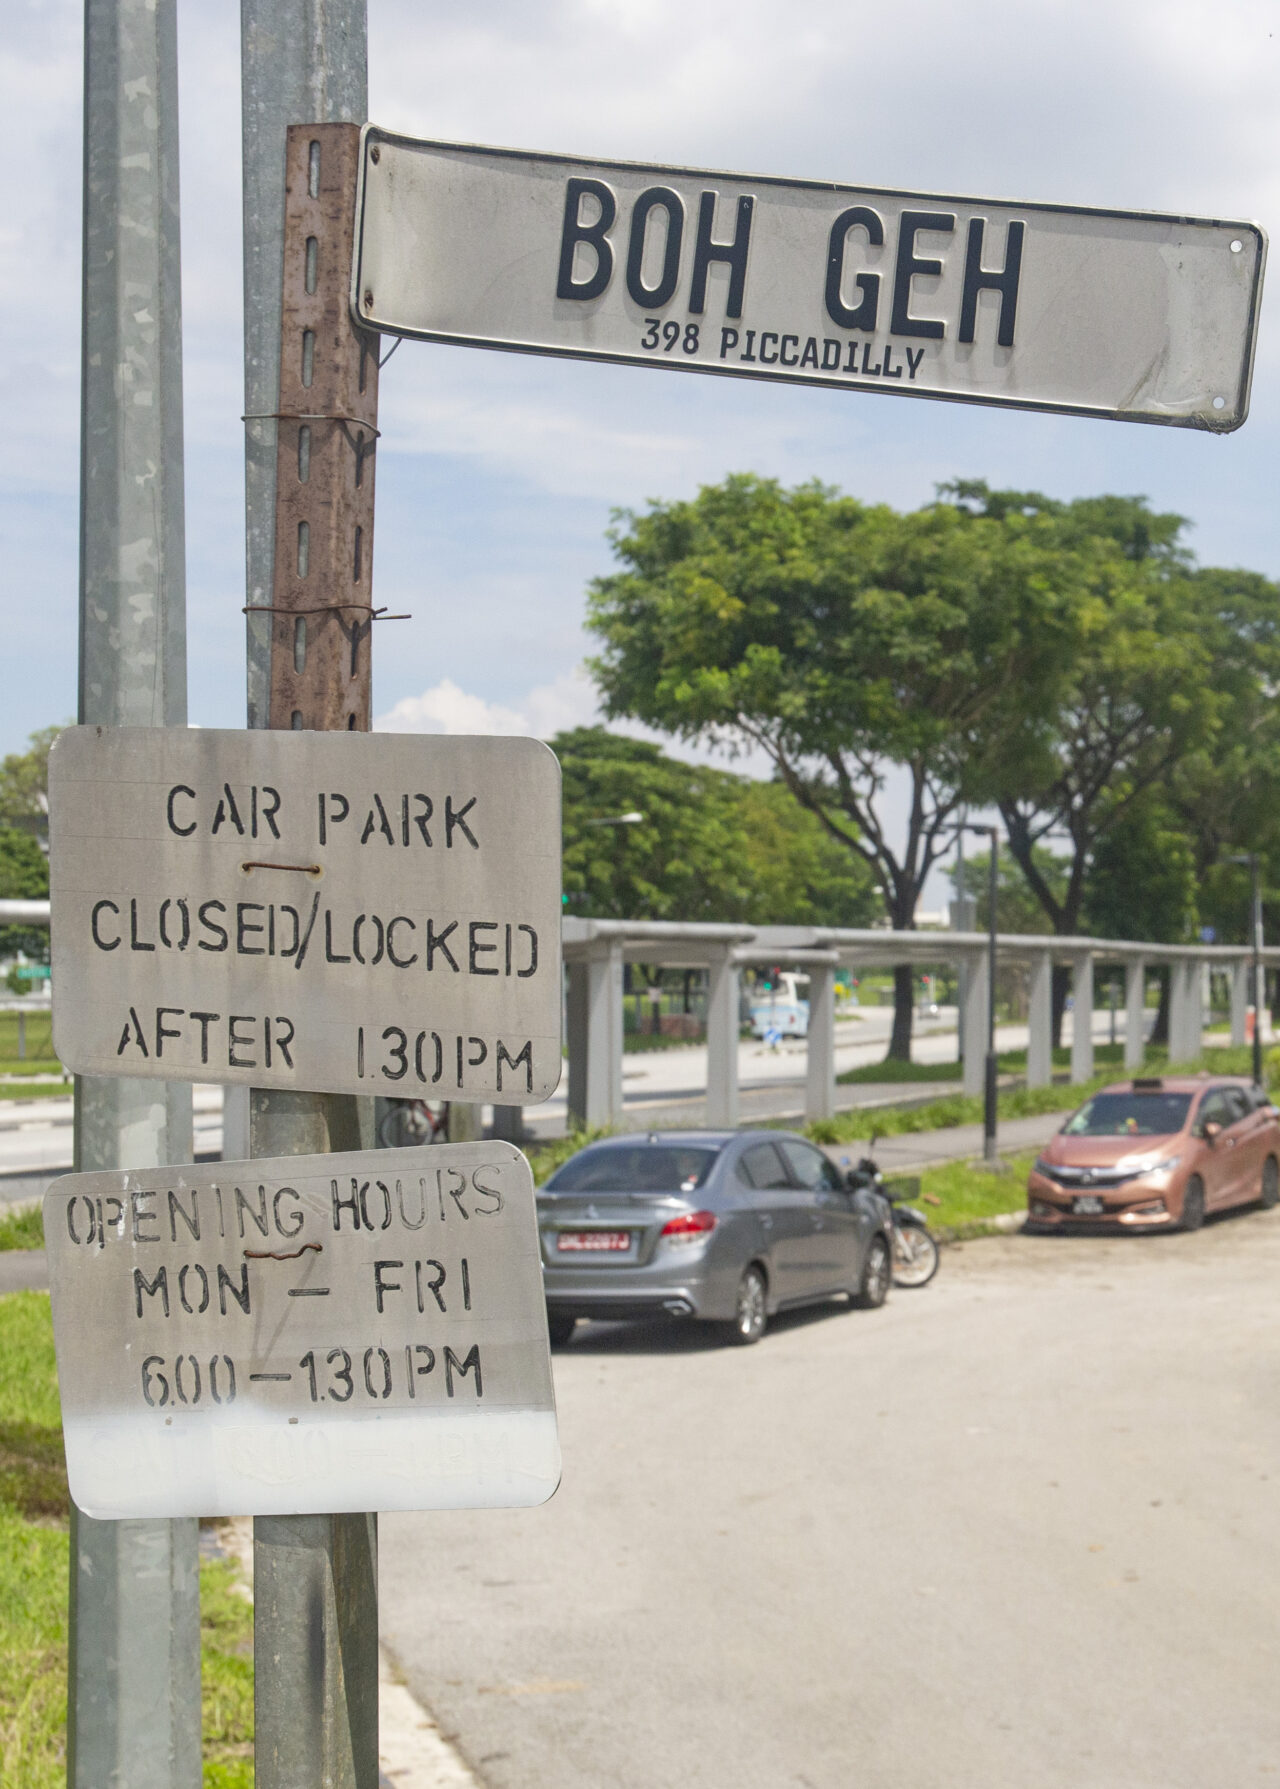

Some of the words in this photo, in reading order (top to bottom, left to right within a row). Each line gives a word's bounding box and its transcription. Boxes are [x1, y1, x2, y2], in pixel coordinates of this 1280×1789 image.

[556, 176, 757, 319] BOH
[824, 205, 1026, 347] GEH
[640, 318, 701, 355] 398
[719, 327, 926, 380] PICCADILLY
[167, 783, 281, 839] CAR
[318, 793, 479, 849] PARK
[92, 891, 538, 977] CLOSED/LOCKED
[117, 1007, 294, 1068] AFTER
[67, 1185, 306, 1249] OPENING
[331, 1164, 505, 1231] HOURS
[134, 1263, 250, 1318] MON
[374, 1258, 471, 1313] FRI
